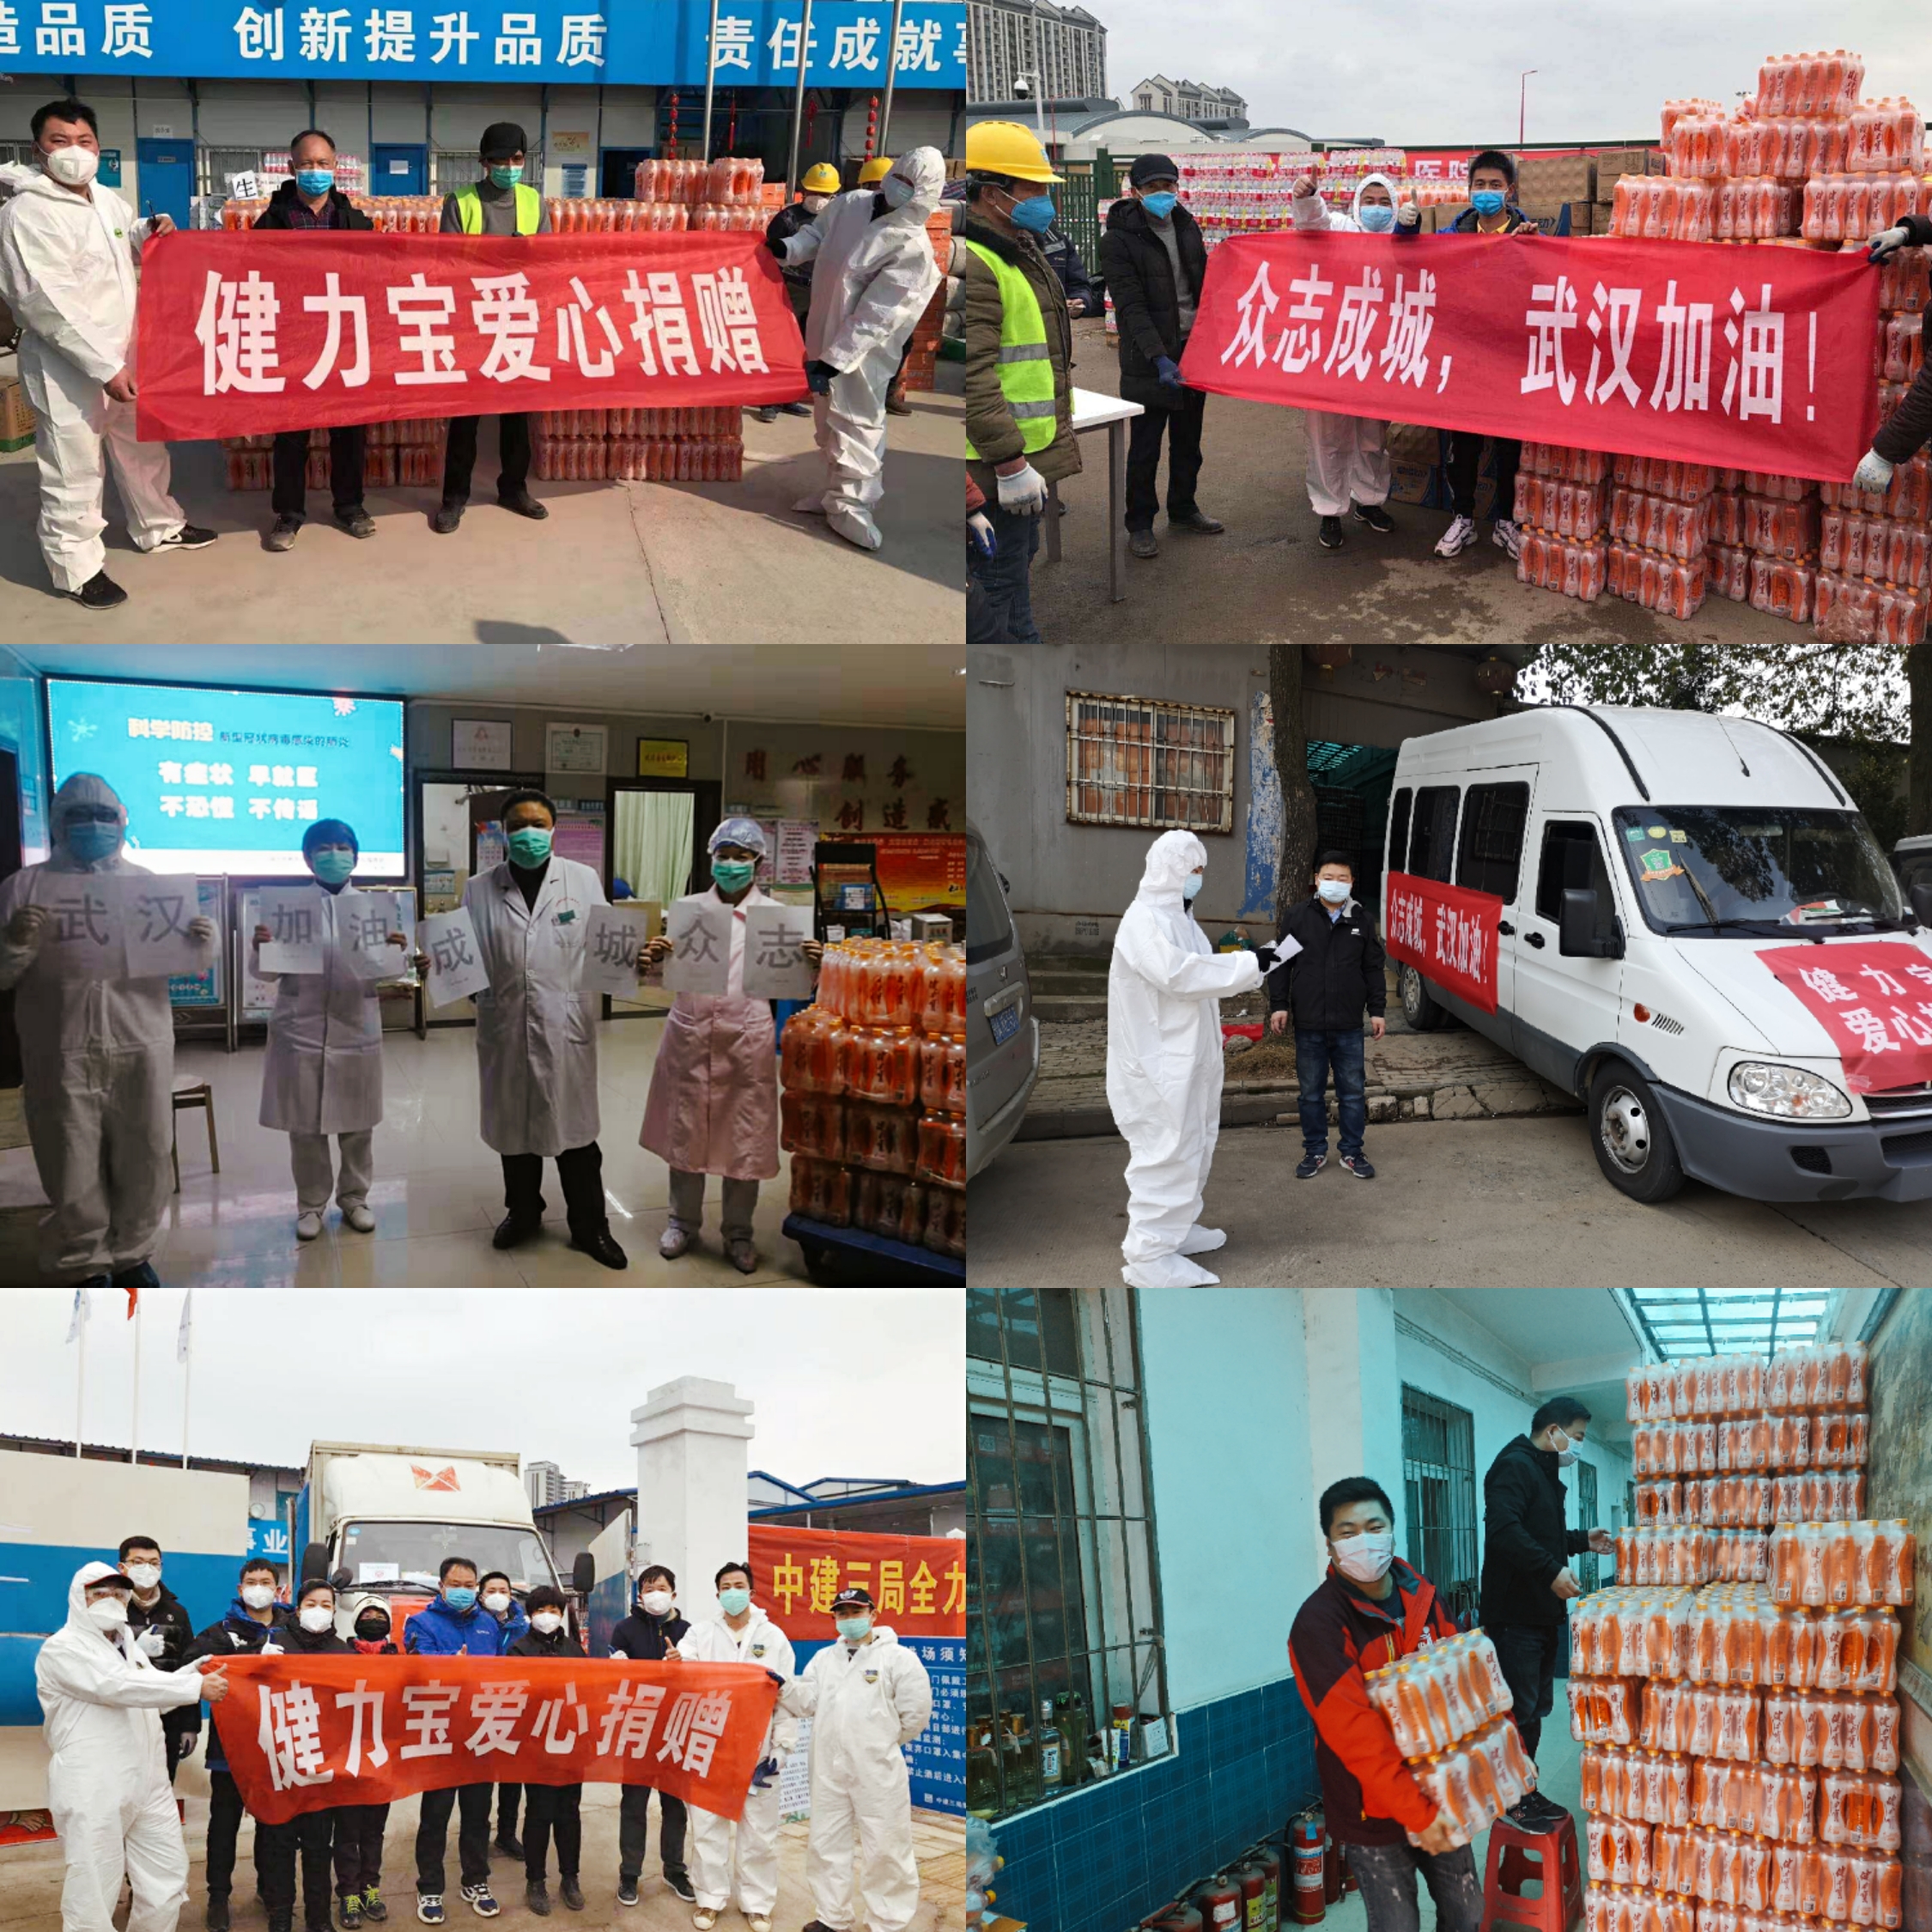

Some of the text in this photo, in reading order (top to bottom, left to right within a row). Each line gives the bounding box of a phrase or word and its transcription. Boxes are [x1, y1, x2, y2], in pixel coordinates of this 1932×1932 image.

[234, 6, 606, 67] 创新提升品质
[706, 16, 966, 71] 责任成就
[195, 266, 769, 396] 健力宝爱心捐赠
[1520, 275, 1818, 424] 武汉加油！
[128, 718, 214, 742] 科学防控
[158, 761, 319, 787] 有症状 早就医
[159, 795, 234, 819] 不恐慌
[51, 894, 110, 946] 武
[137, 893, 191, 943] 汉
[271, 903, 313, 945] 加
[349, 908, 388, 952] 油
[677, 919, 720, 963] 众
[431, 927, 474, 975] 成
[593, 922, 637, 968] 城
[756, 923, 805, 969] 志
[1839, 1002, 1932, 1054] 爱心
[773, 1553, 966, 1617] 中建三局全力
[258, 1678, 732, 1792] 健力宝爱心捐赠
